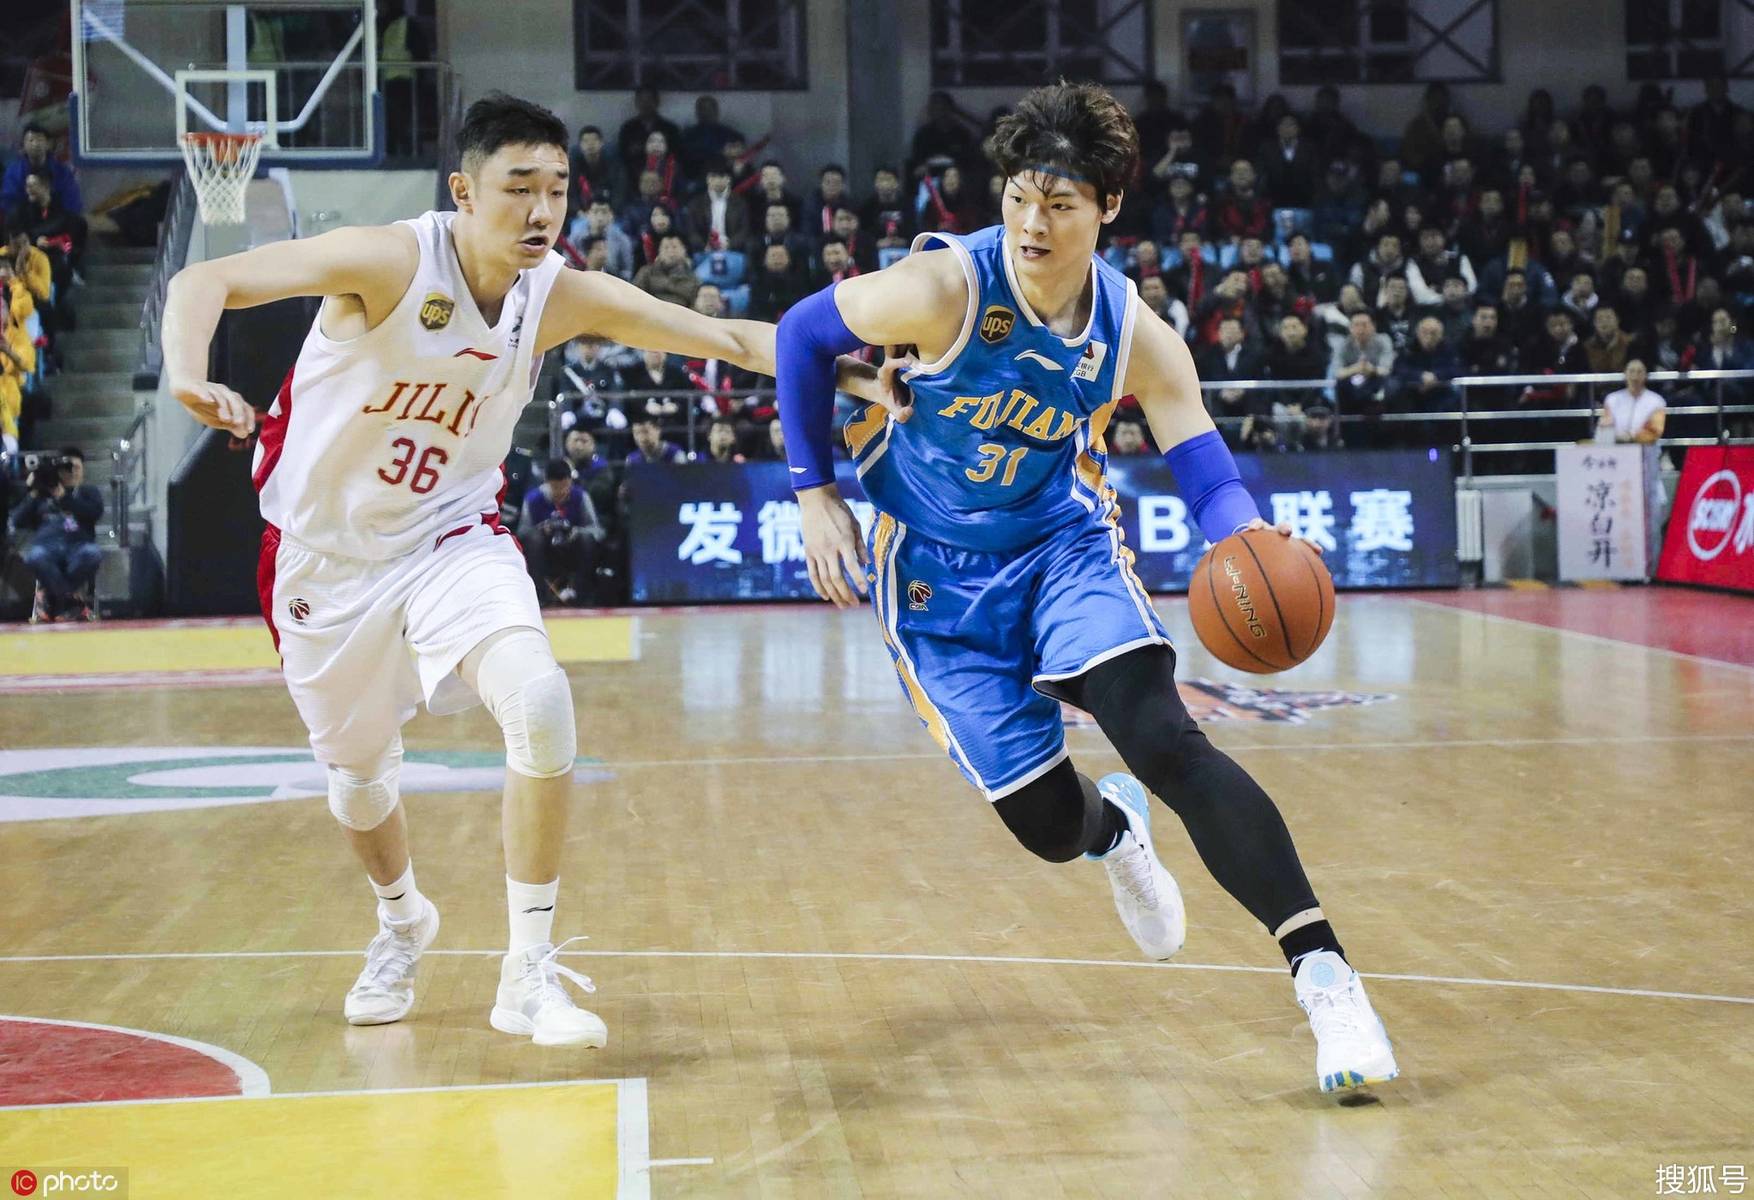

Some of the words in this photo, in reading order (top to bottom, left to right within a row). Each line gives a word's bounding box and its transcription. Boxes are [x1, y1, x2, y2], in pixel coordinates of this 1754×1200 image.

[421, 303, 450, 325] ups
[983, 316, 1010, 337] ups
[377, 437, 448, 494] 36
[965, 443, 1029, 486] 31
